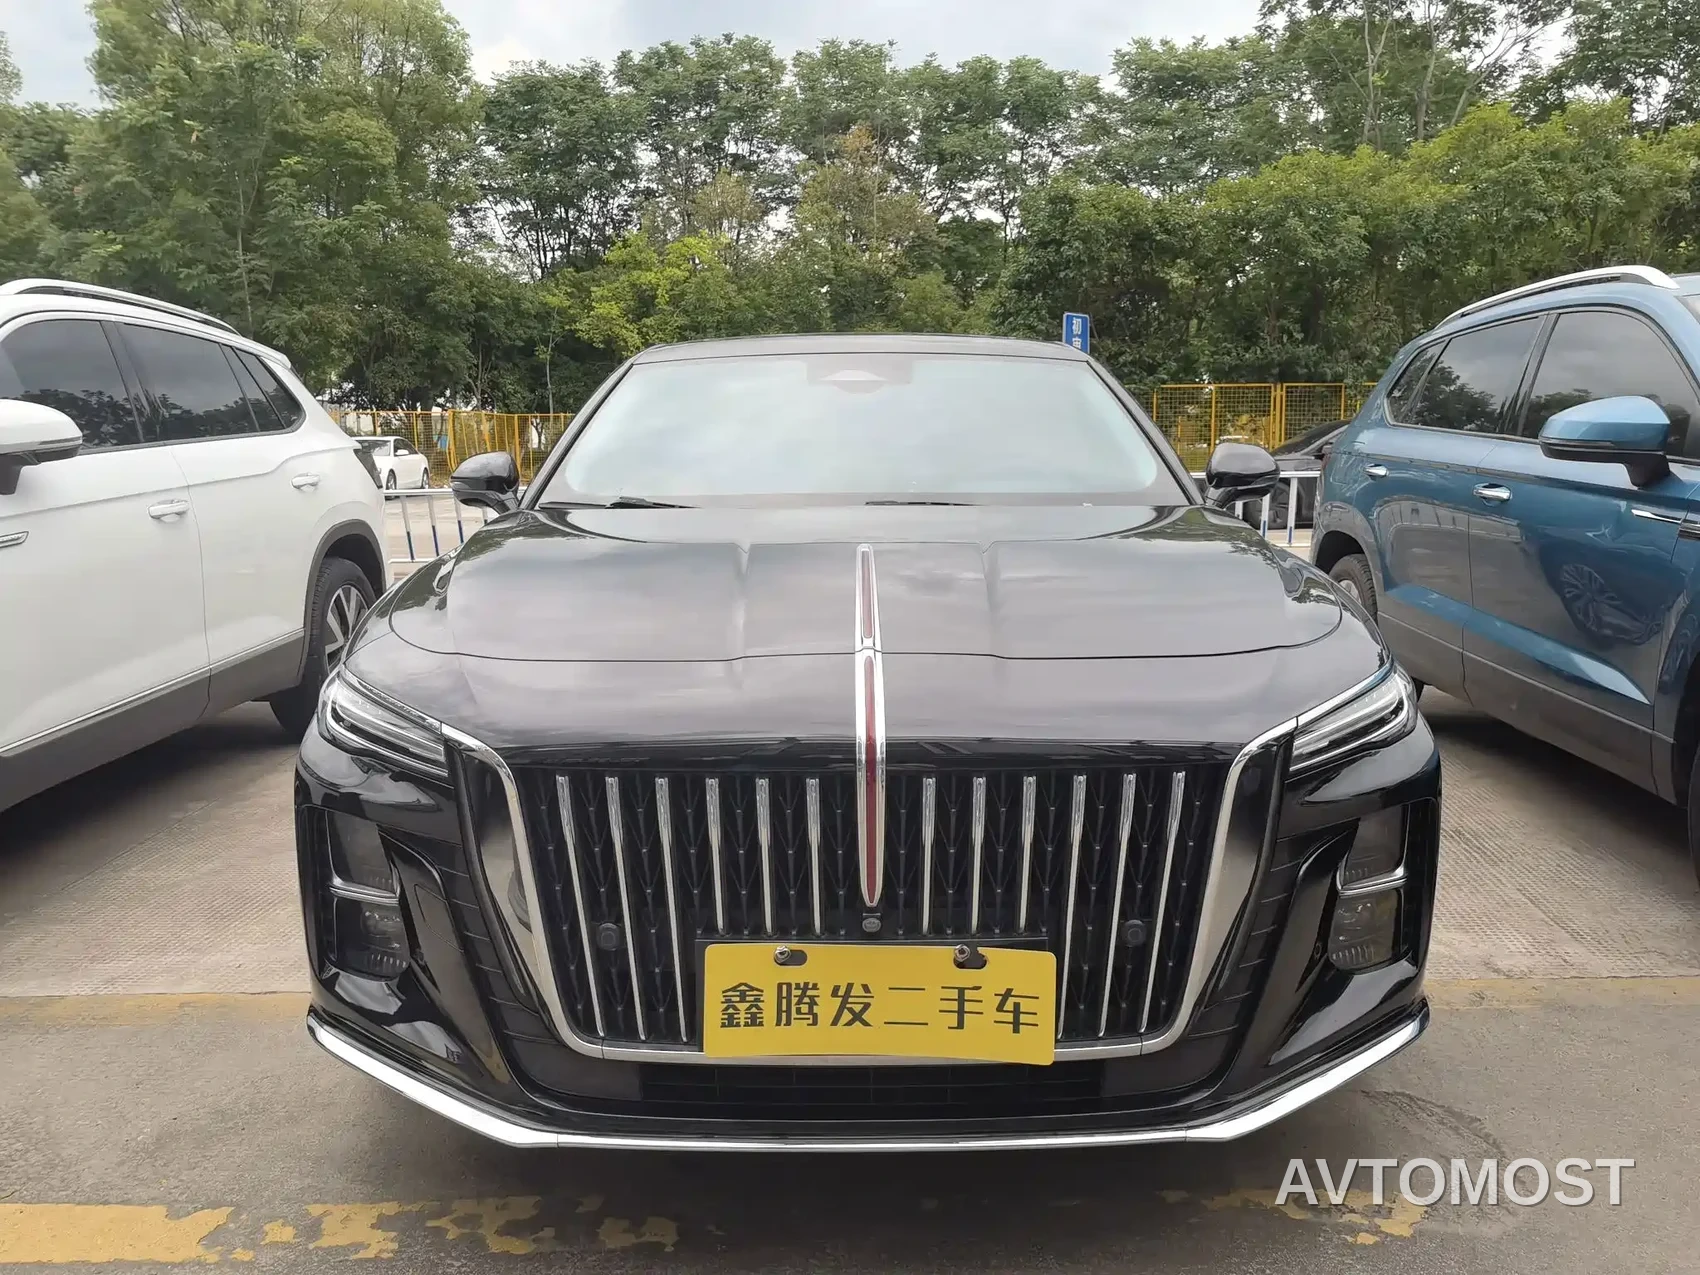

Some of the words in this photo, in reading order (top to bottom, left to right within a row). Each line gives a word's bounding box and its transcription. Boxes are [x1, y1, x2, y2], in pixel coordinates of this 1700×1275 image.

[720, 982, 1040, 1034] 鑫腾发二手车
